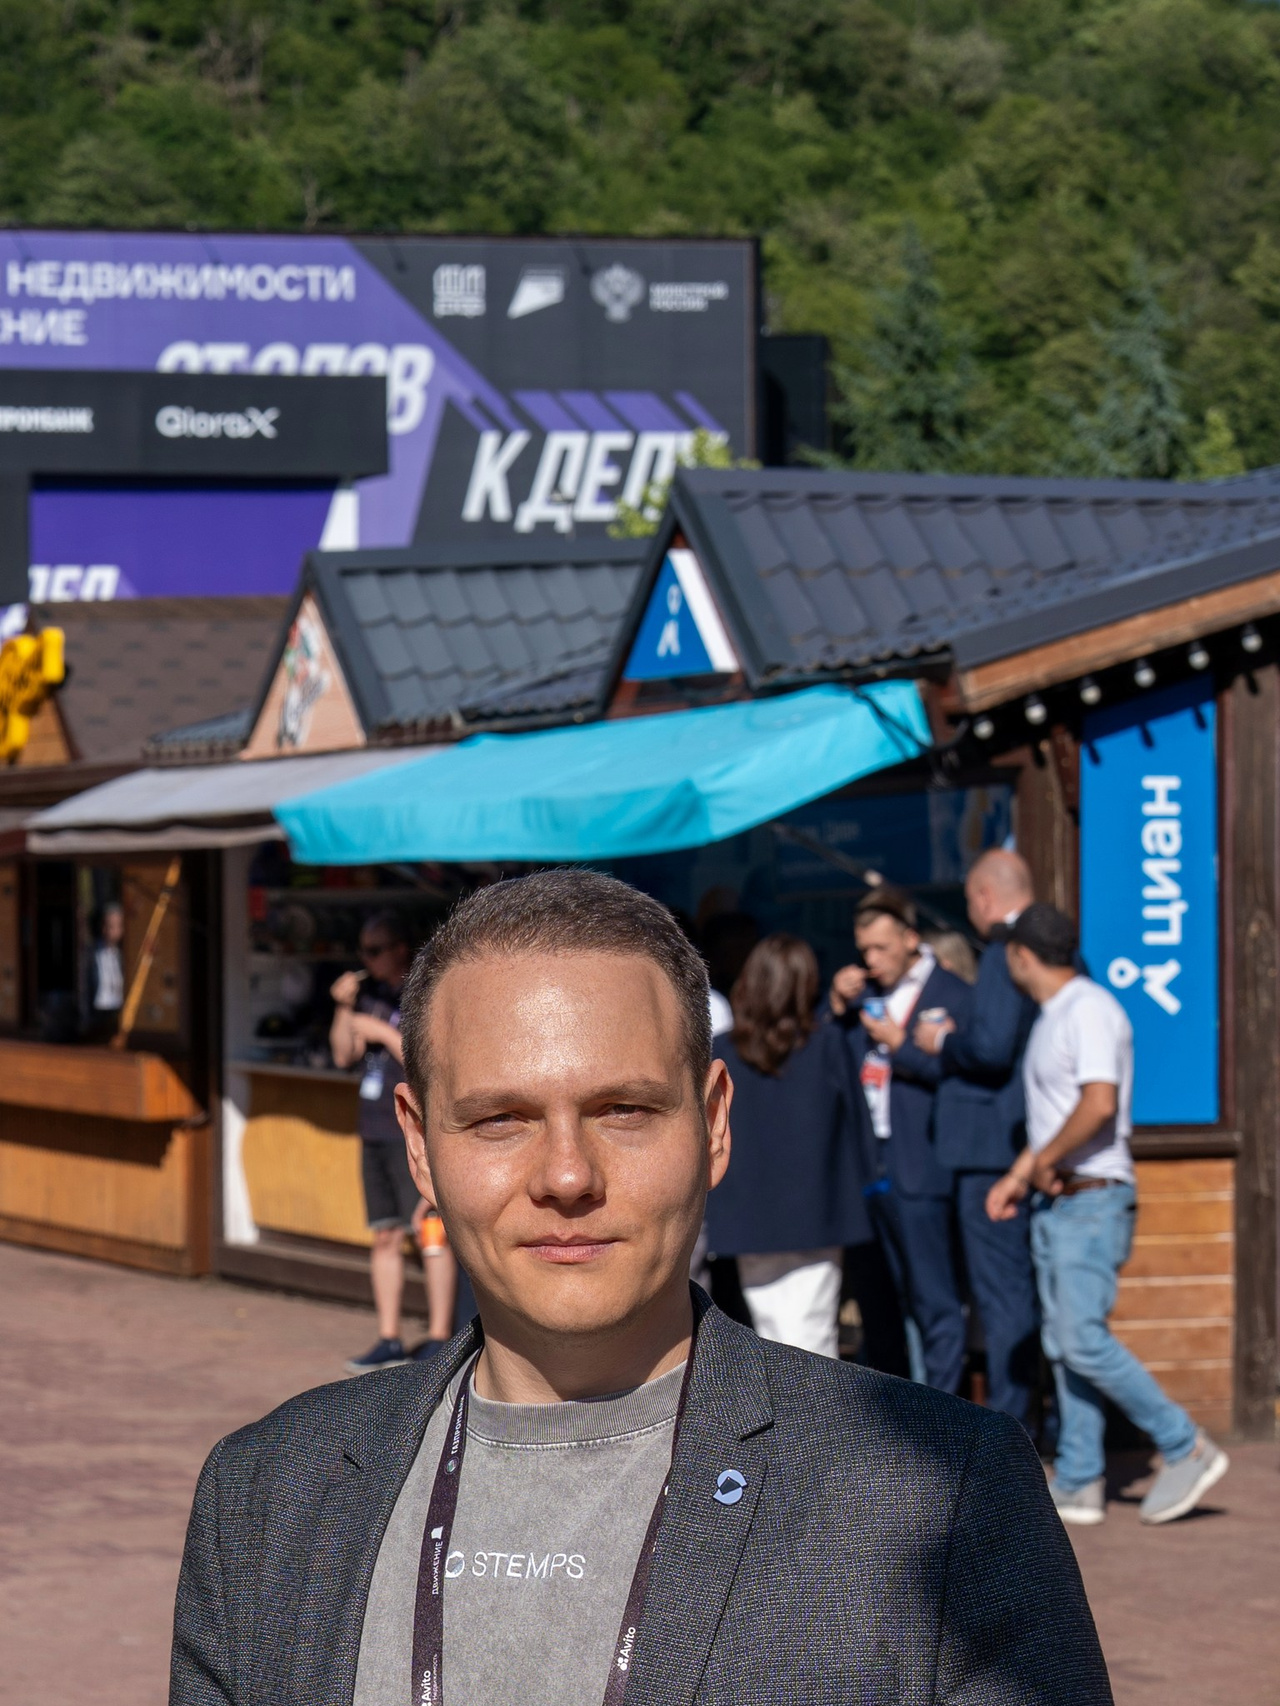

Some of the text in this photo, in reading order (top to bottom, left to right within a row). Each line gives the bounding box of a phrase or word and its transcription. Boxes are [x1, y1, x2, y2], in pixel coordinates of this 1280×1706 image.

[7, 260, 356, 305] НЕДВИЖИМОСТИ
[461, 430, 532, 522] К
[1141, 774, 1190, 947] циан
[431, 1541, 443, 1595] ДВИЖЕНИЕ
[472, 1551, 586, 1579] STEMPS
[621, 1626, 637, 1658] Avito
[421, 1670, 432, 1701] Avito
